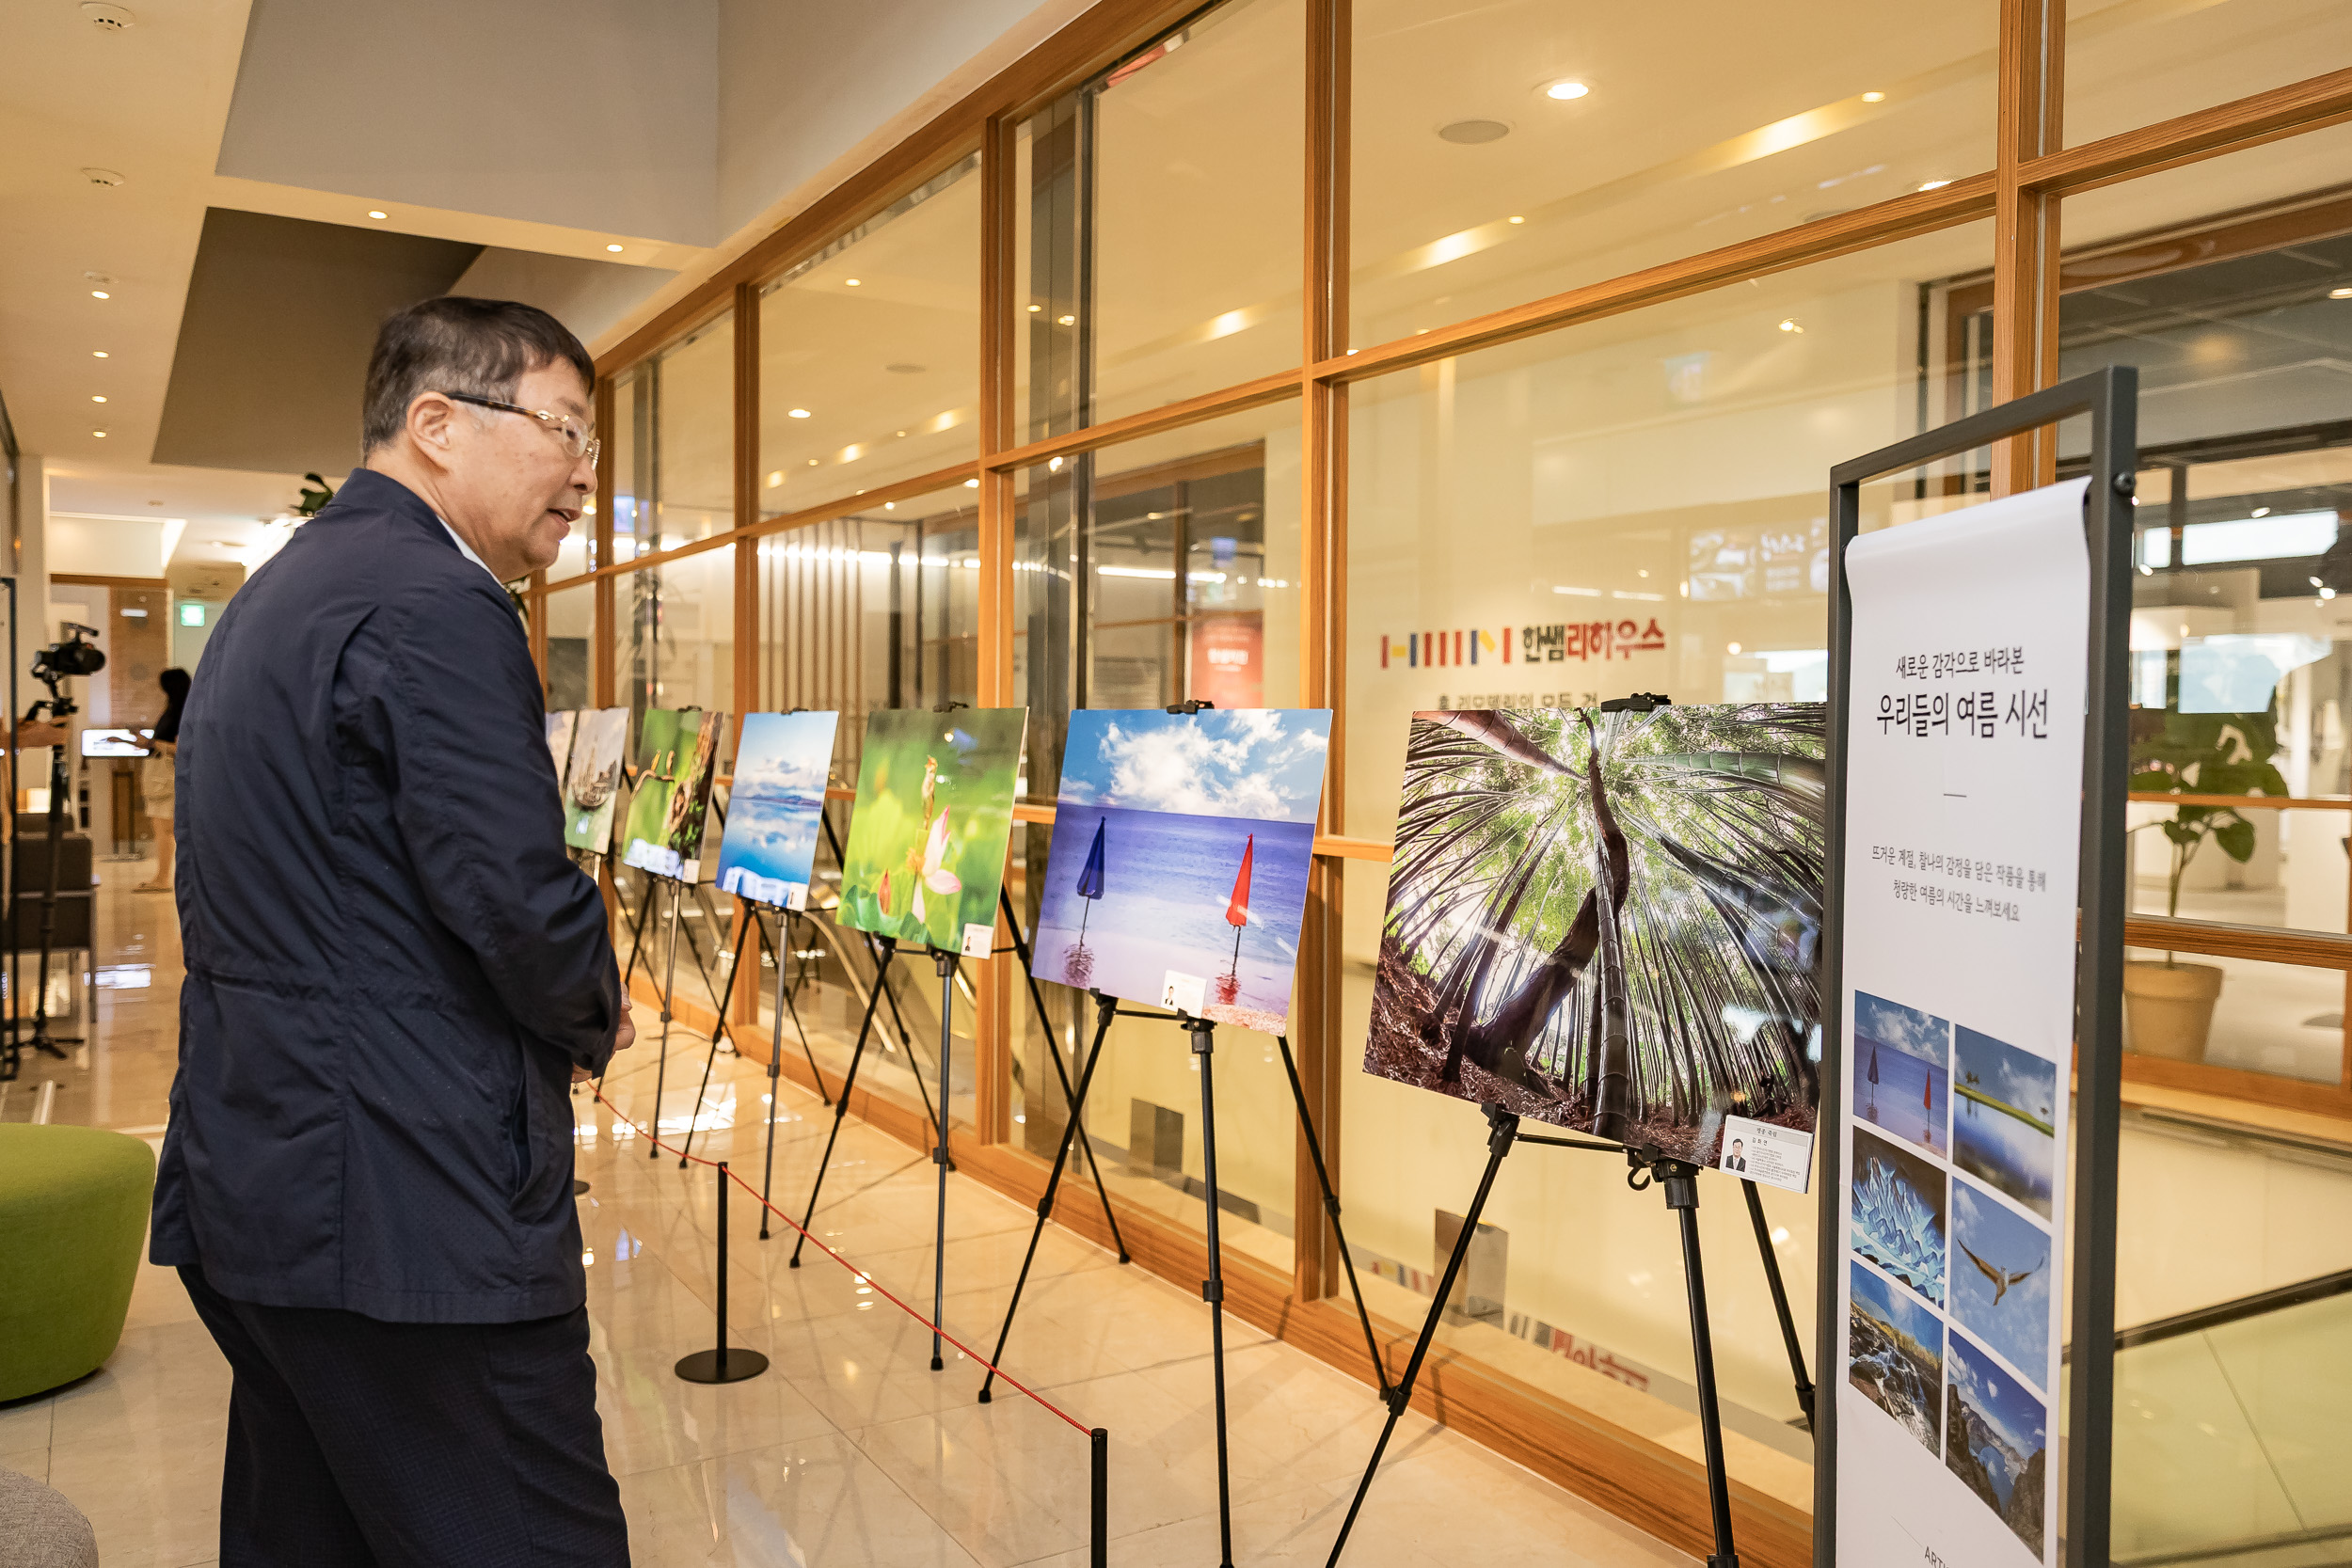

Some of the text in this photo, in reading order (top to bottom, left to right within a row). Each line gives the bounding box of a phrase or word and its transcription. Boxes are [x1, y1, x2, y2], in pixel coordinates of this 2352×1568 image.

[1896, 645, 2025, 680] 새로운 감각으로 바라본
[1876, 688, 2048, 739] 우리들의 여름 시선
[1871, 846, 2047, 893] 뜨거운 계절, 찰나의 감정을 담은 작품을 통해
[1919, 885, 1945, 907] 여름의
[1947, 890, 1973, 914] 시간을
[1975, 896, 2021, 922] 느껴보세요
